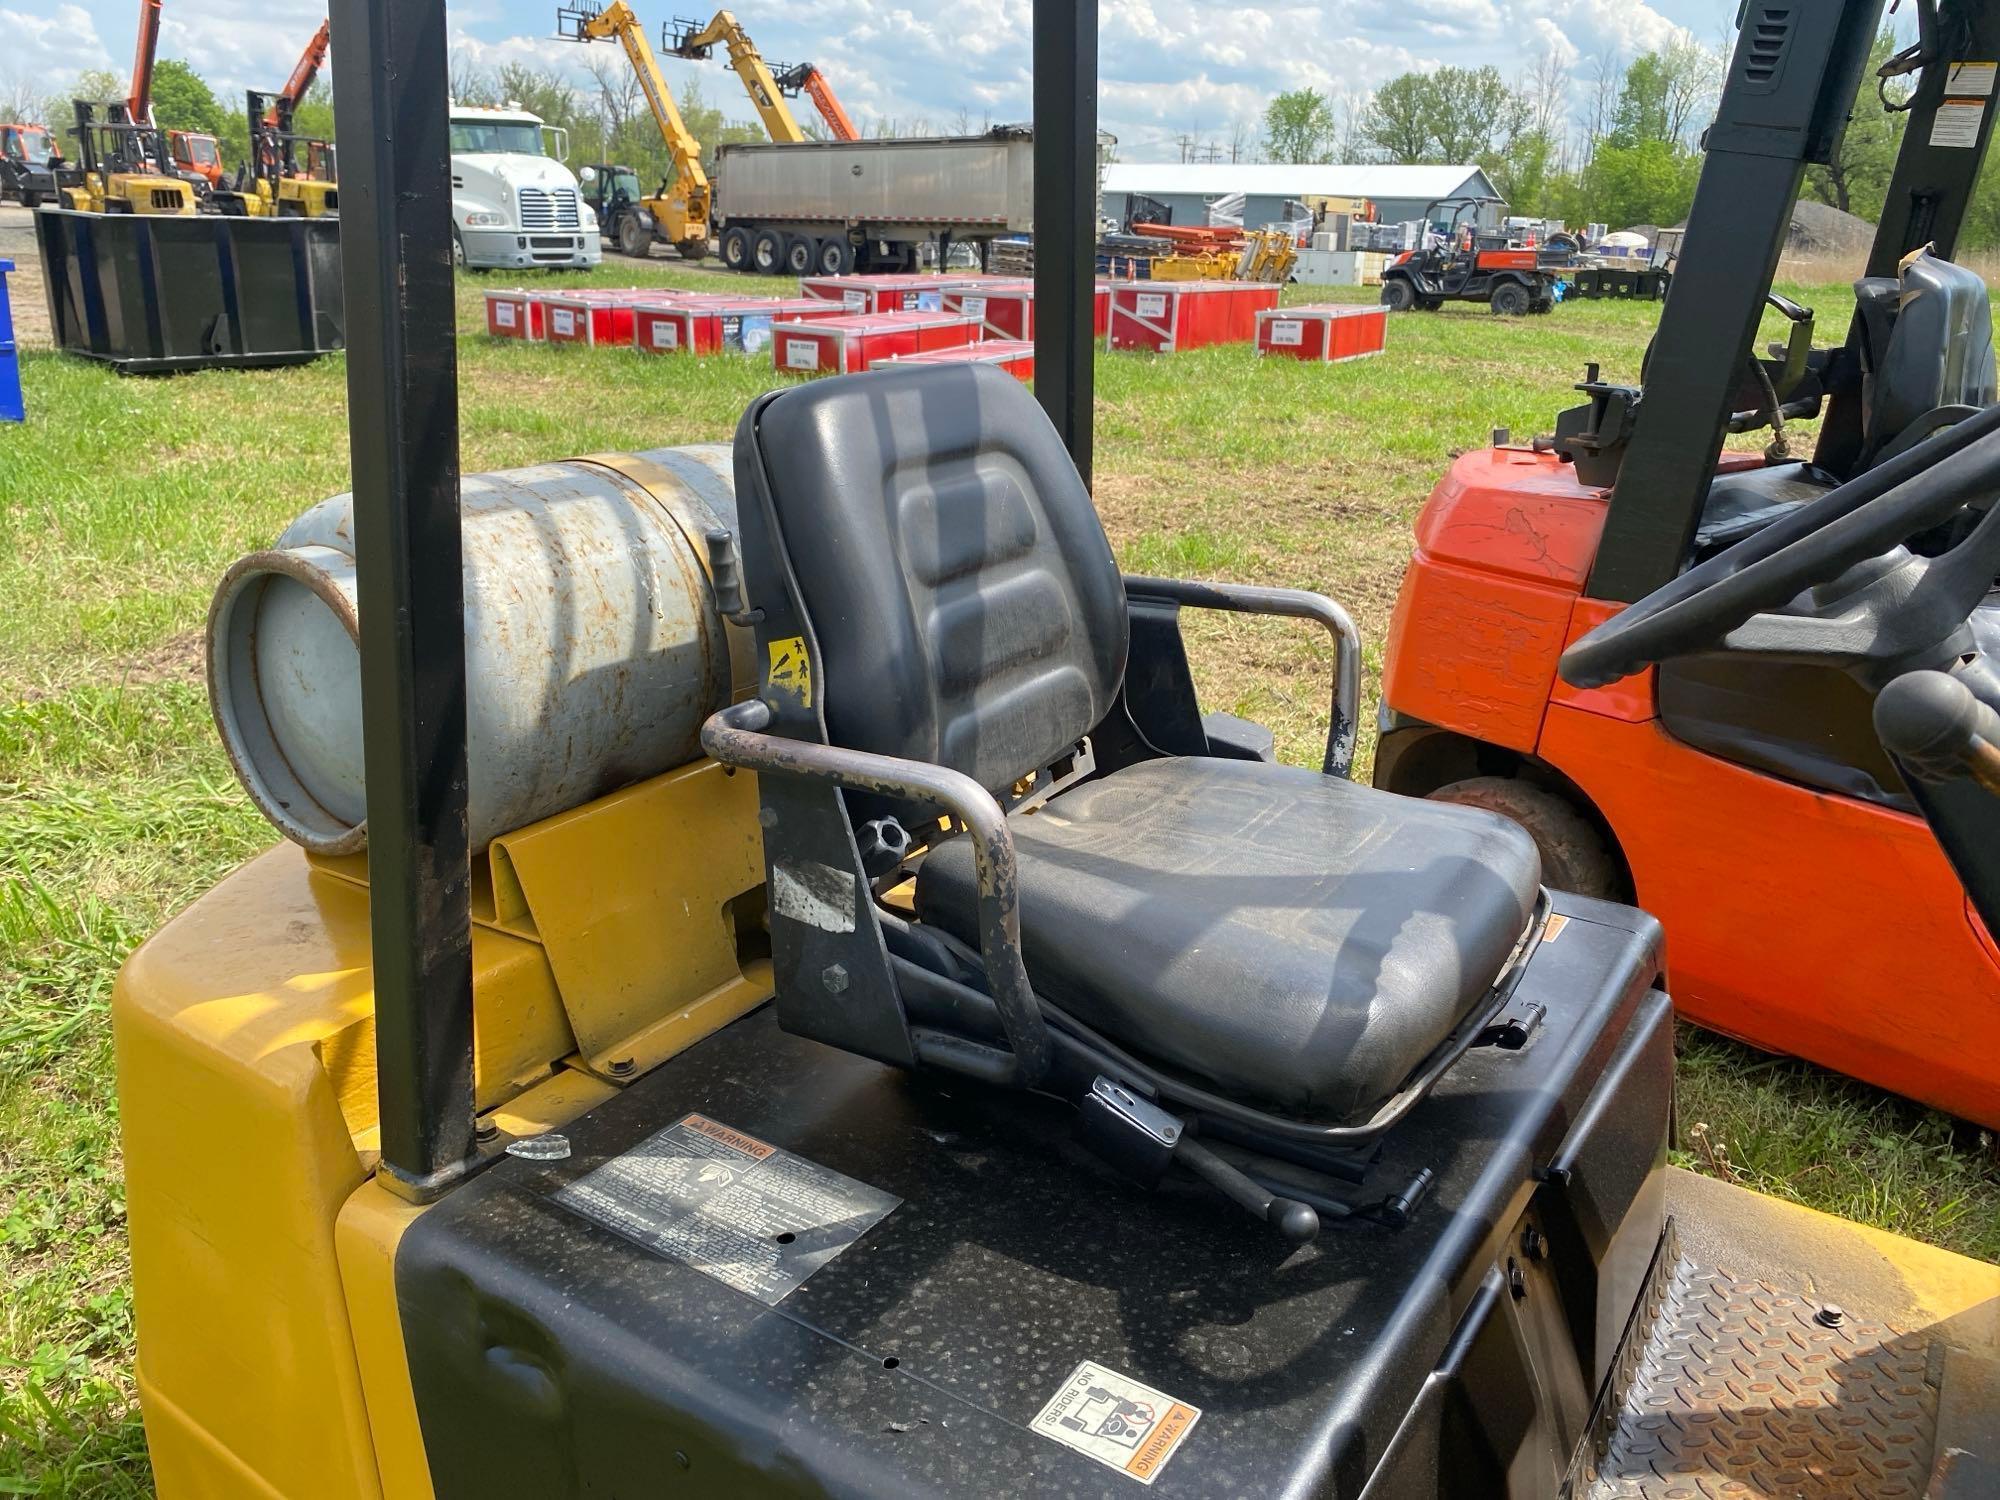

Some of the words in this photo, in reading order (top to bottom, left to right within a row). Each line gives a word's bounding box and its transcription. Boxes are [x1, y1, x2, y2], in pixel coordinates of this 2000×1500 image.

[703, 1126, 767, 1156] WARNING
[1077, 1371, 1094, 1387] NO
[1042, 1388, 1079, 1426] RIDERS!
[1136, 1423, 1180, 1472] WARNING
